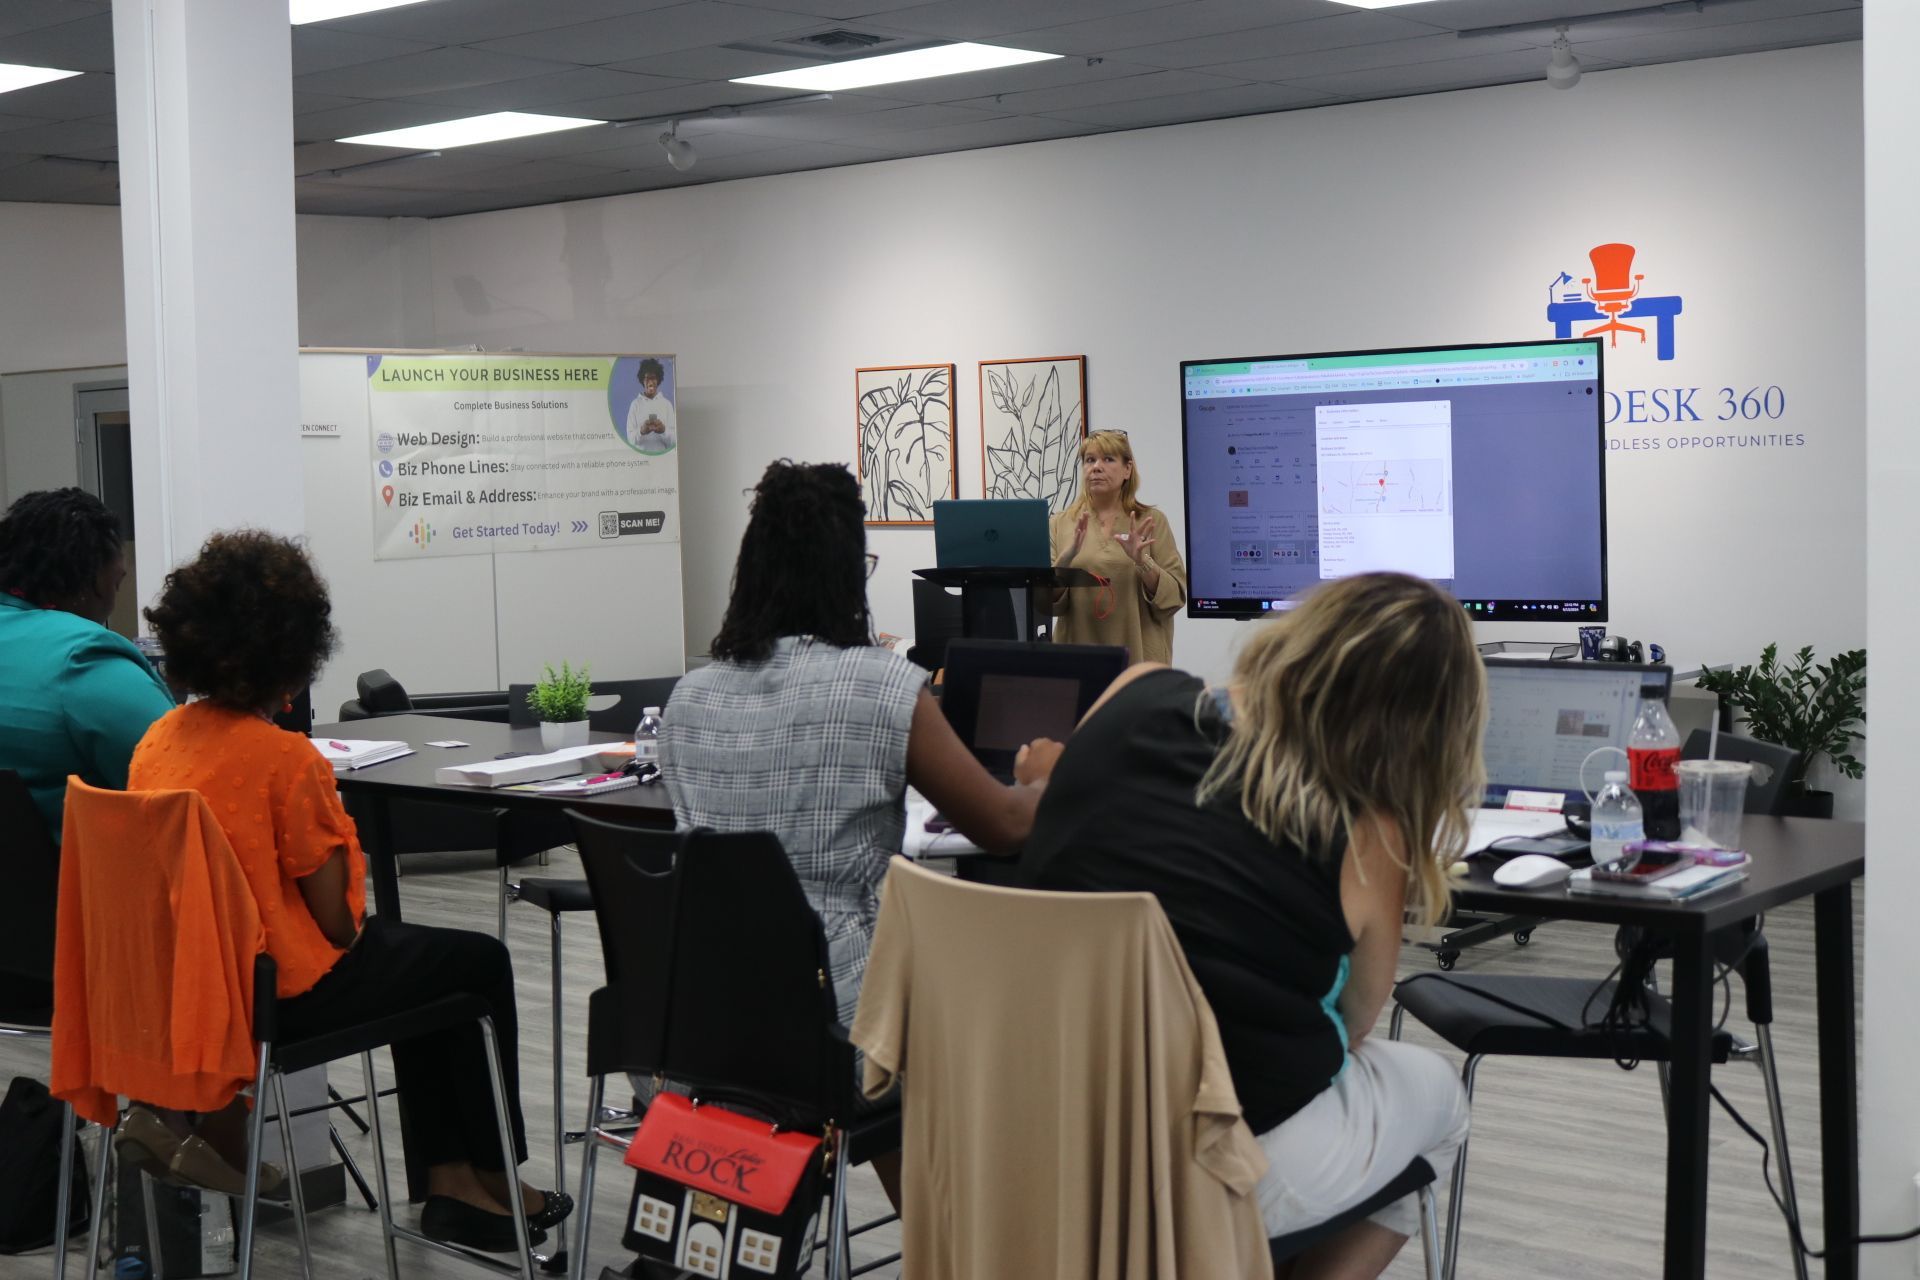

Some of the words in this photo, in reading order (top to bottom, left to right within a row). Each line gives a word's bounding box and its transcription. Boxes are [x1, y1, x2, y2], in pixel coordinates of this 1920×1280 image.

[382, 368, 444, 382] LAUNCH
[449, 368, 489, 381] YOUR
[493, 368, 560, 381] BUSINESS
[564, 368, 599, 381] HERE
[454, 401, 493, 411] Complete
[494, 400, 530, 410] Business
[531, 399, 568, 410] Solutions
[1605, 387, 1704, 424] DESK
[1717, 385, 1785, 421] 360
[311, 424, 337, 432] CONNECT
[397, 432, 428, 447] Web
[431, 431, 480, 448] Design:
[481, 434, 500, 442] Build
[506, 433, 545, 443] professional
[546, 433, 572, 441] website
[572, 433, 586, 441] that
[1605, 438, 1661, 451] DLESS
[1667, 434, 1805, 449] OPPORTUNITIES
[398, 462, 417, 476] Biz
[421, 460, 466, 475] Phone
[469, 460, 509, 474] Lines:
[511, 463, 524, 472] Stay
[526, 461, 560, 471] connected
[561, 461, 575, 470] with
[581, 461, 604, 469] reliable
[606, 460, 626, 469] phone
[399, 492, 418, 507] Biz
[422, 490, 463, 506] Email
[466, 491, 476, 504] &
[479, 489, 537, 503] Address:
[537, 491, 564, 500] Enhance
[565, 492, 580, 501] your
[581, 490, 600, 498] brand
[600, 489, 613, 497] with
[620, 487, 656, 498] professional
[452, 526, 473, 540] Get
[476, 524, 520, 538] Started
[521, 522, 561, 538] Today!
[620, 518, 644, 528] SCAN
[645, 517, 660, 527] ME!
[661, 1139, 759, 1193] ROCK
